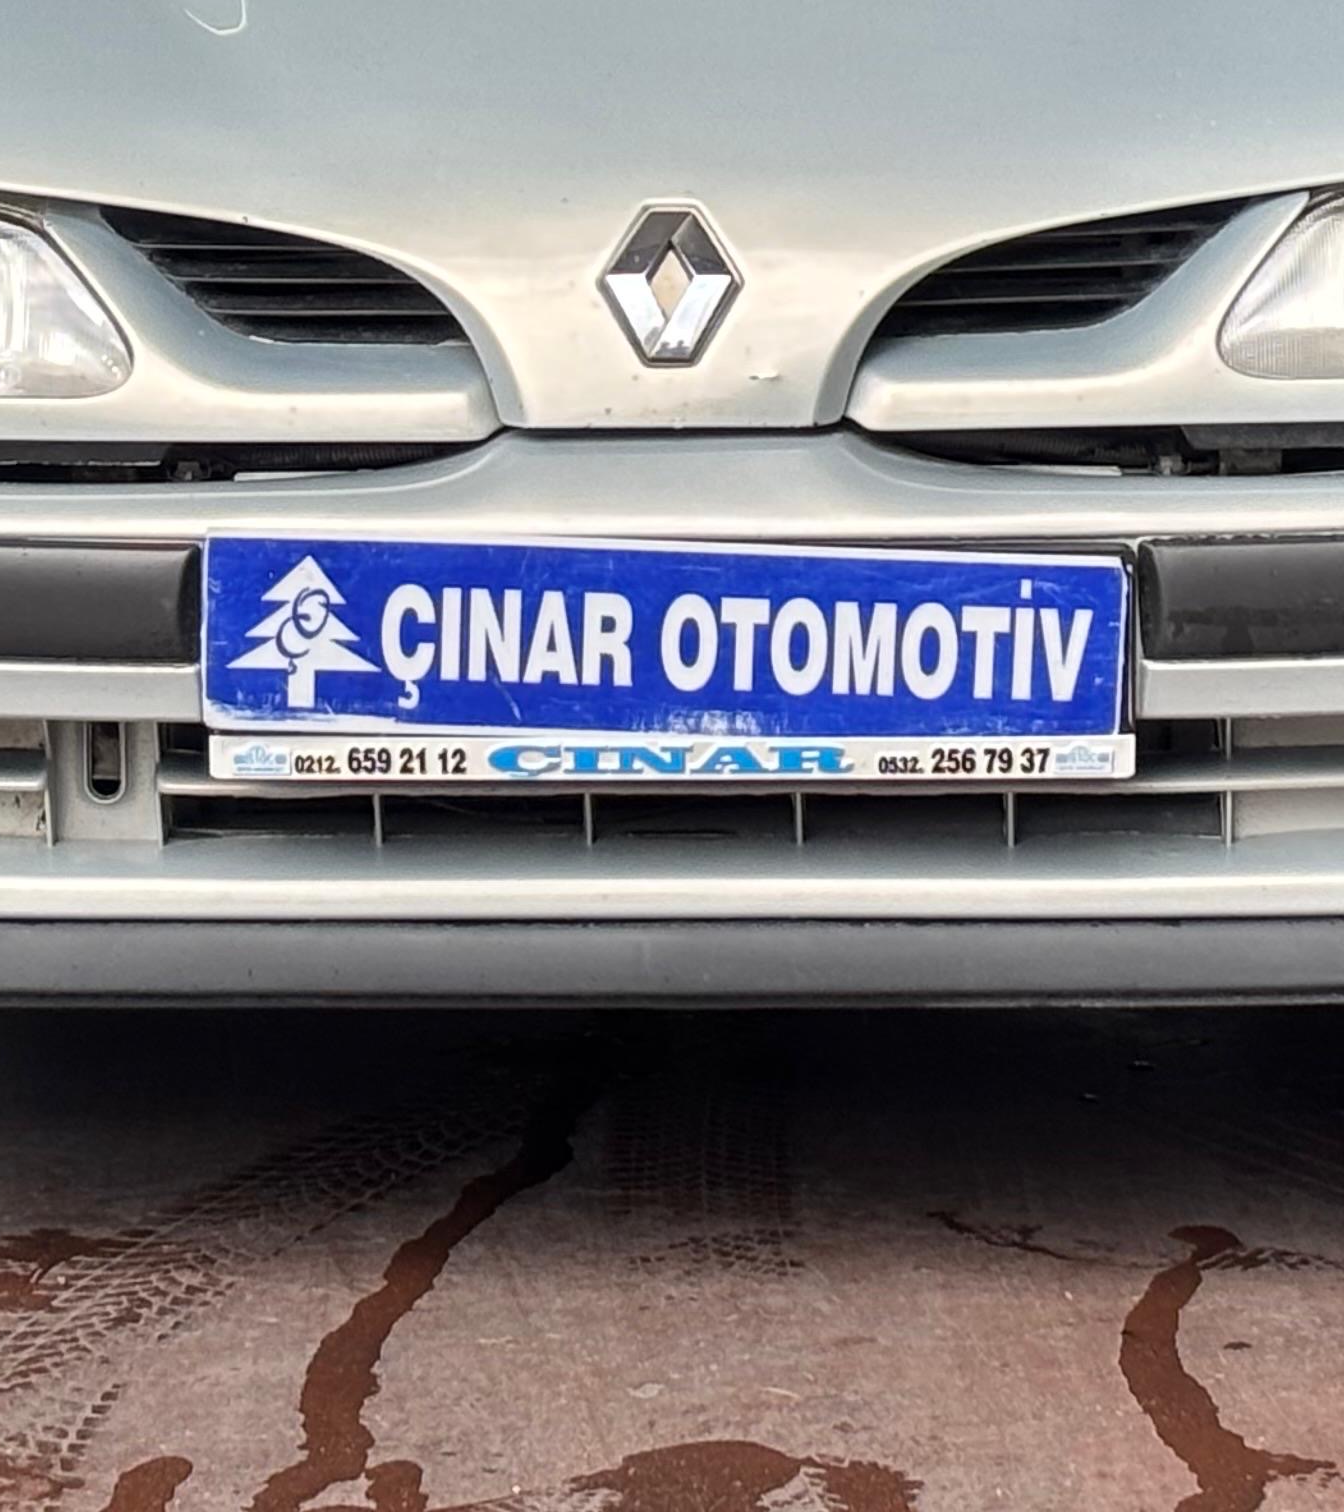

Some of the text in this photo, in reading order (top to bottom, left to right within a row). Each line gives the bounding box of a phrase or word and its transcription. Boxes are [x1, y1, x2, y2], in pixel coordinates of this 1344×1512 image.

[381, 583, 634, 710] ÇINAR
[660, 578, 1094, 703] OTOMOTİV
[294, 754, 342, 774] 0212.
[347, 747, 392, 774] 659
[399, 747, 427, 774] 21
[437, 747, 467, 774] 12
[488, 743, 854, 778] ÇINAR
[931, 748, 976, 774] 256
[983, 748, 1013, 774] 79
[1020, 748, 1050, 774] 37
